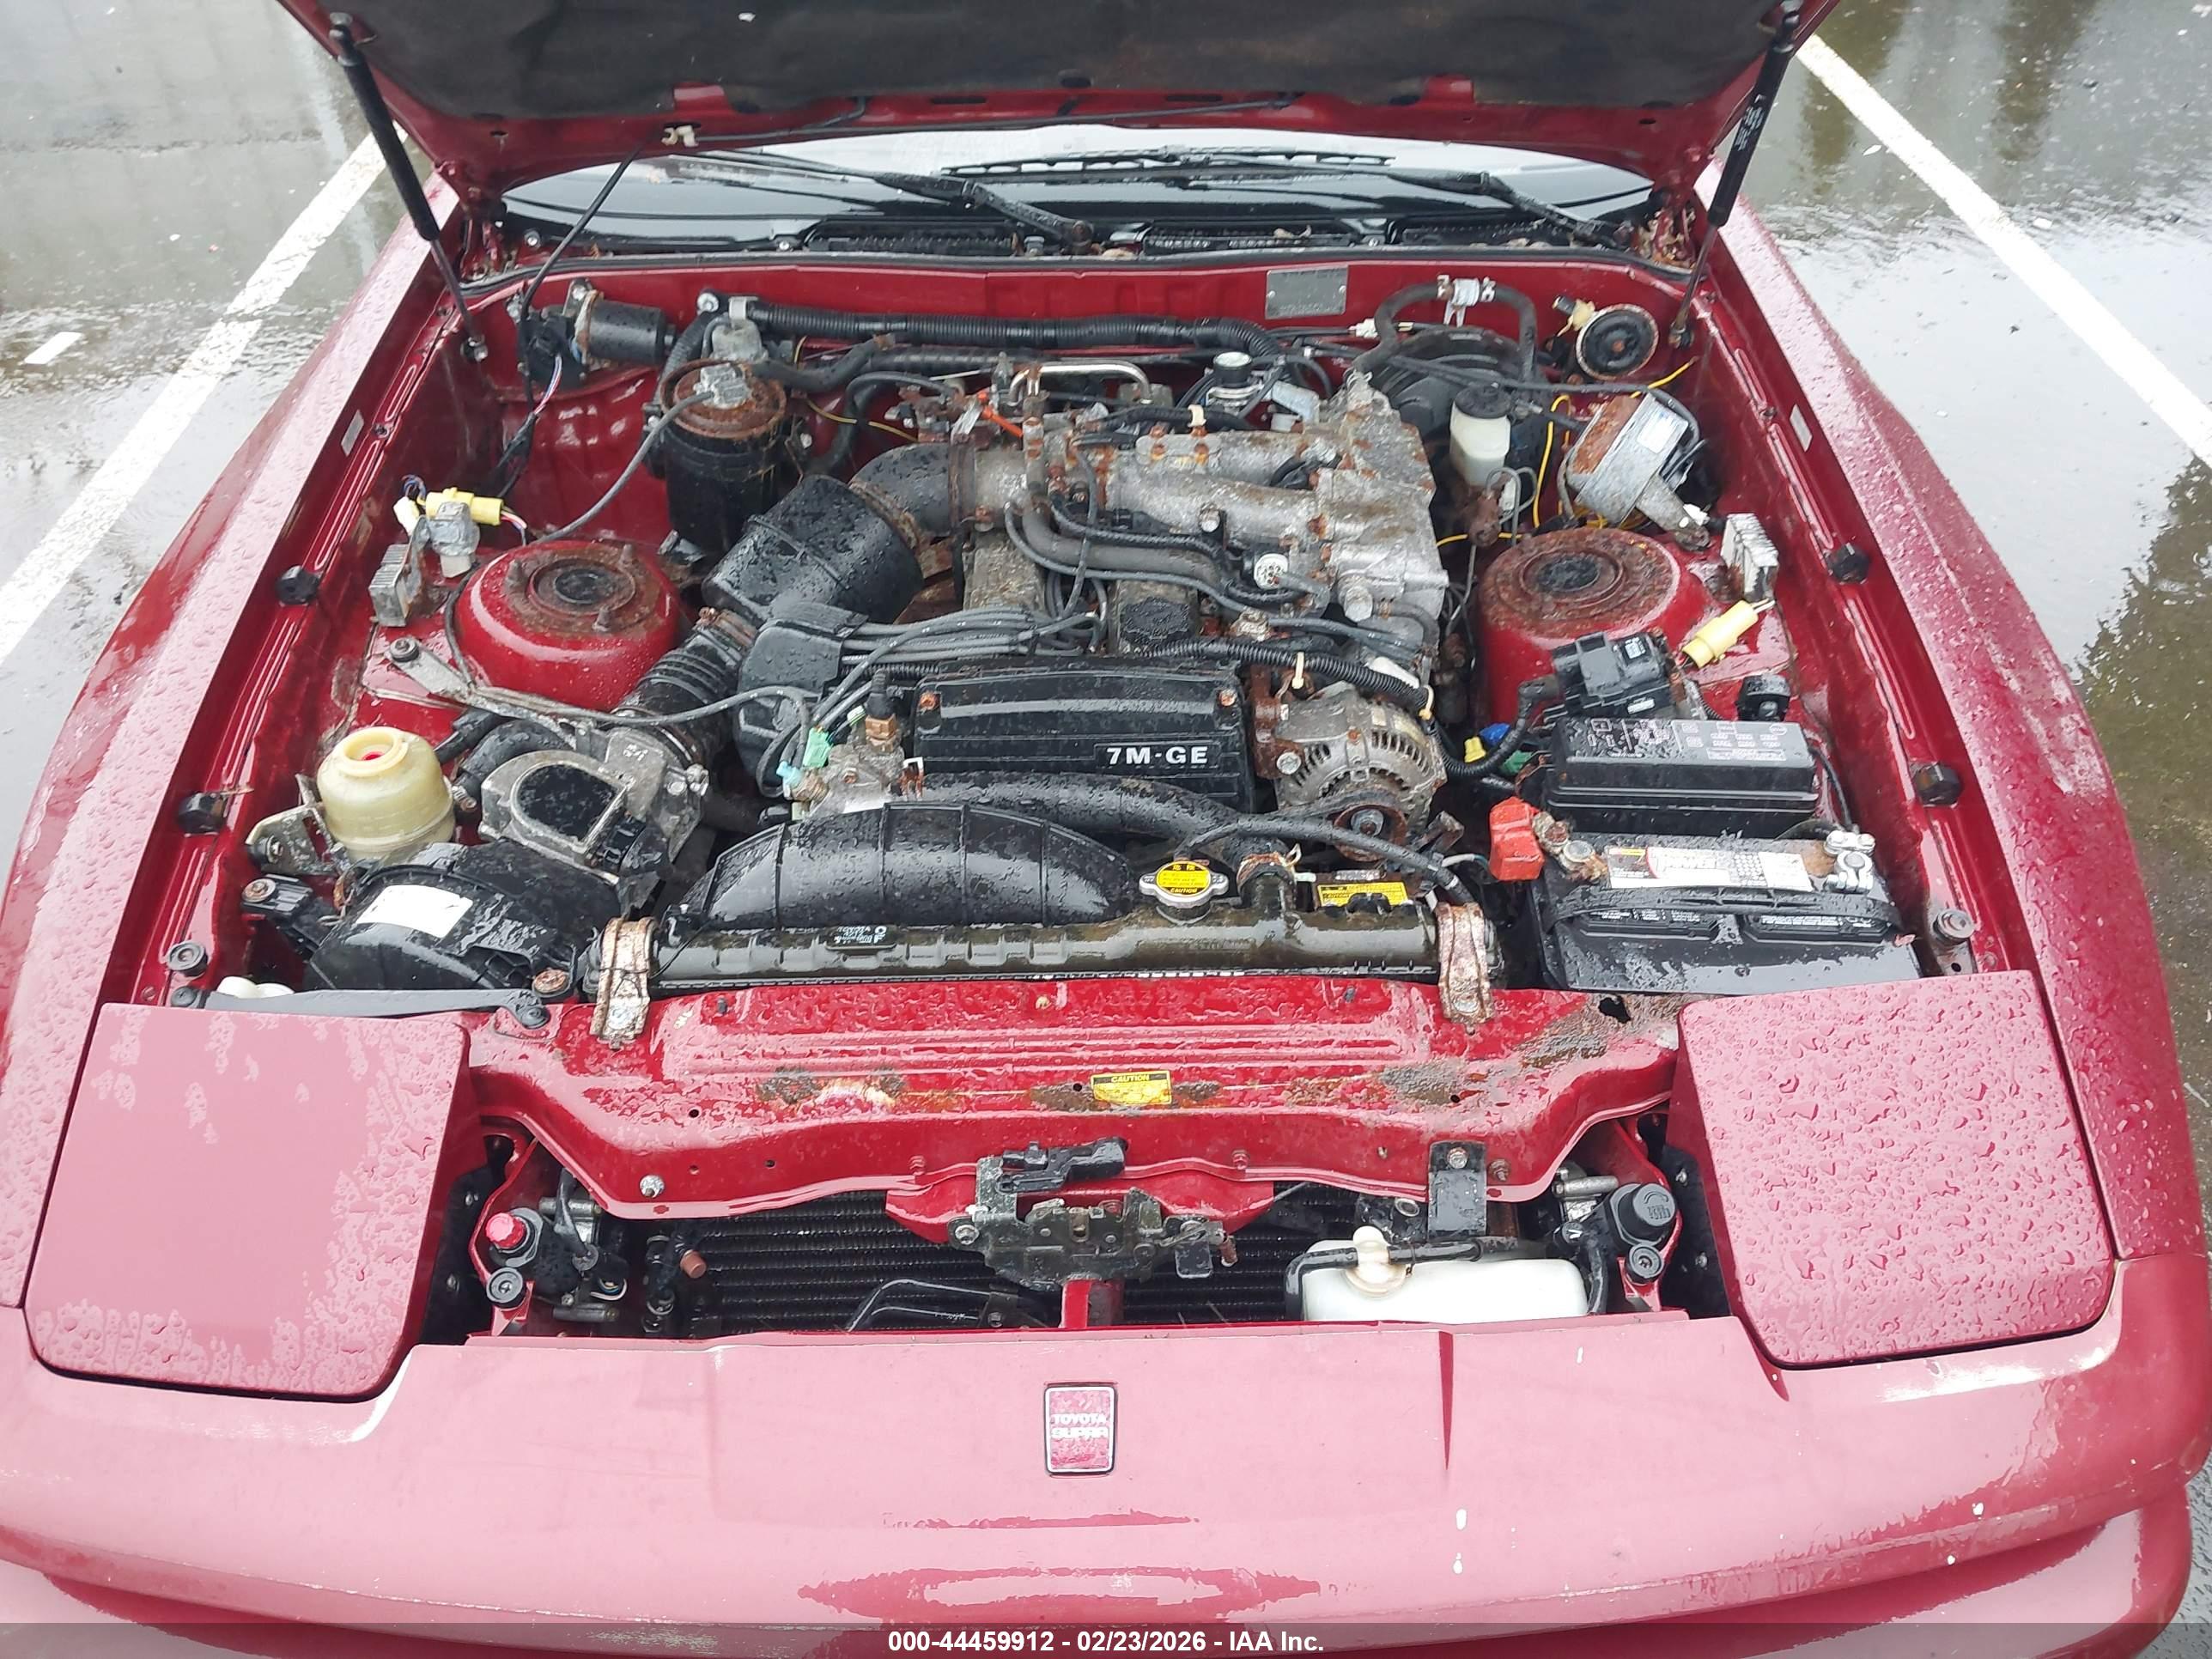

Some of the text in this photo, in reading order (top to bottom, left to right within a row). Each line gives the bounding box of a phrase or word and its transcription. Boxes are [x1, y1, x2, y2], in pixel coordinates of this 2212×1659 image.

[1106, 745, 1208, 765] 7M-GE
[1110, 1073, 1151, 1083] CAUTION
[1050, 1413, 1108, 1425] TOYOTA
